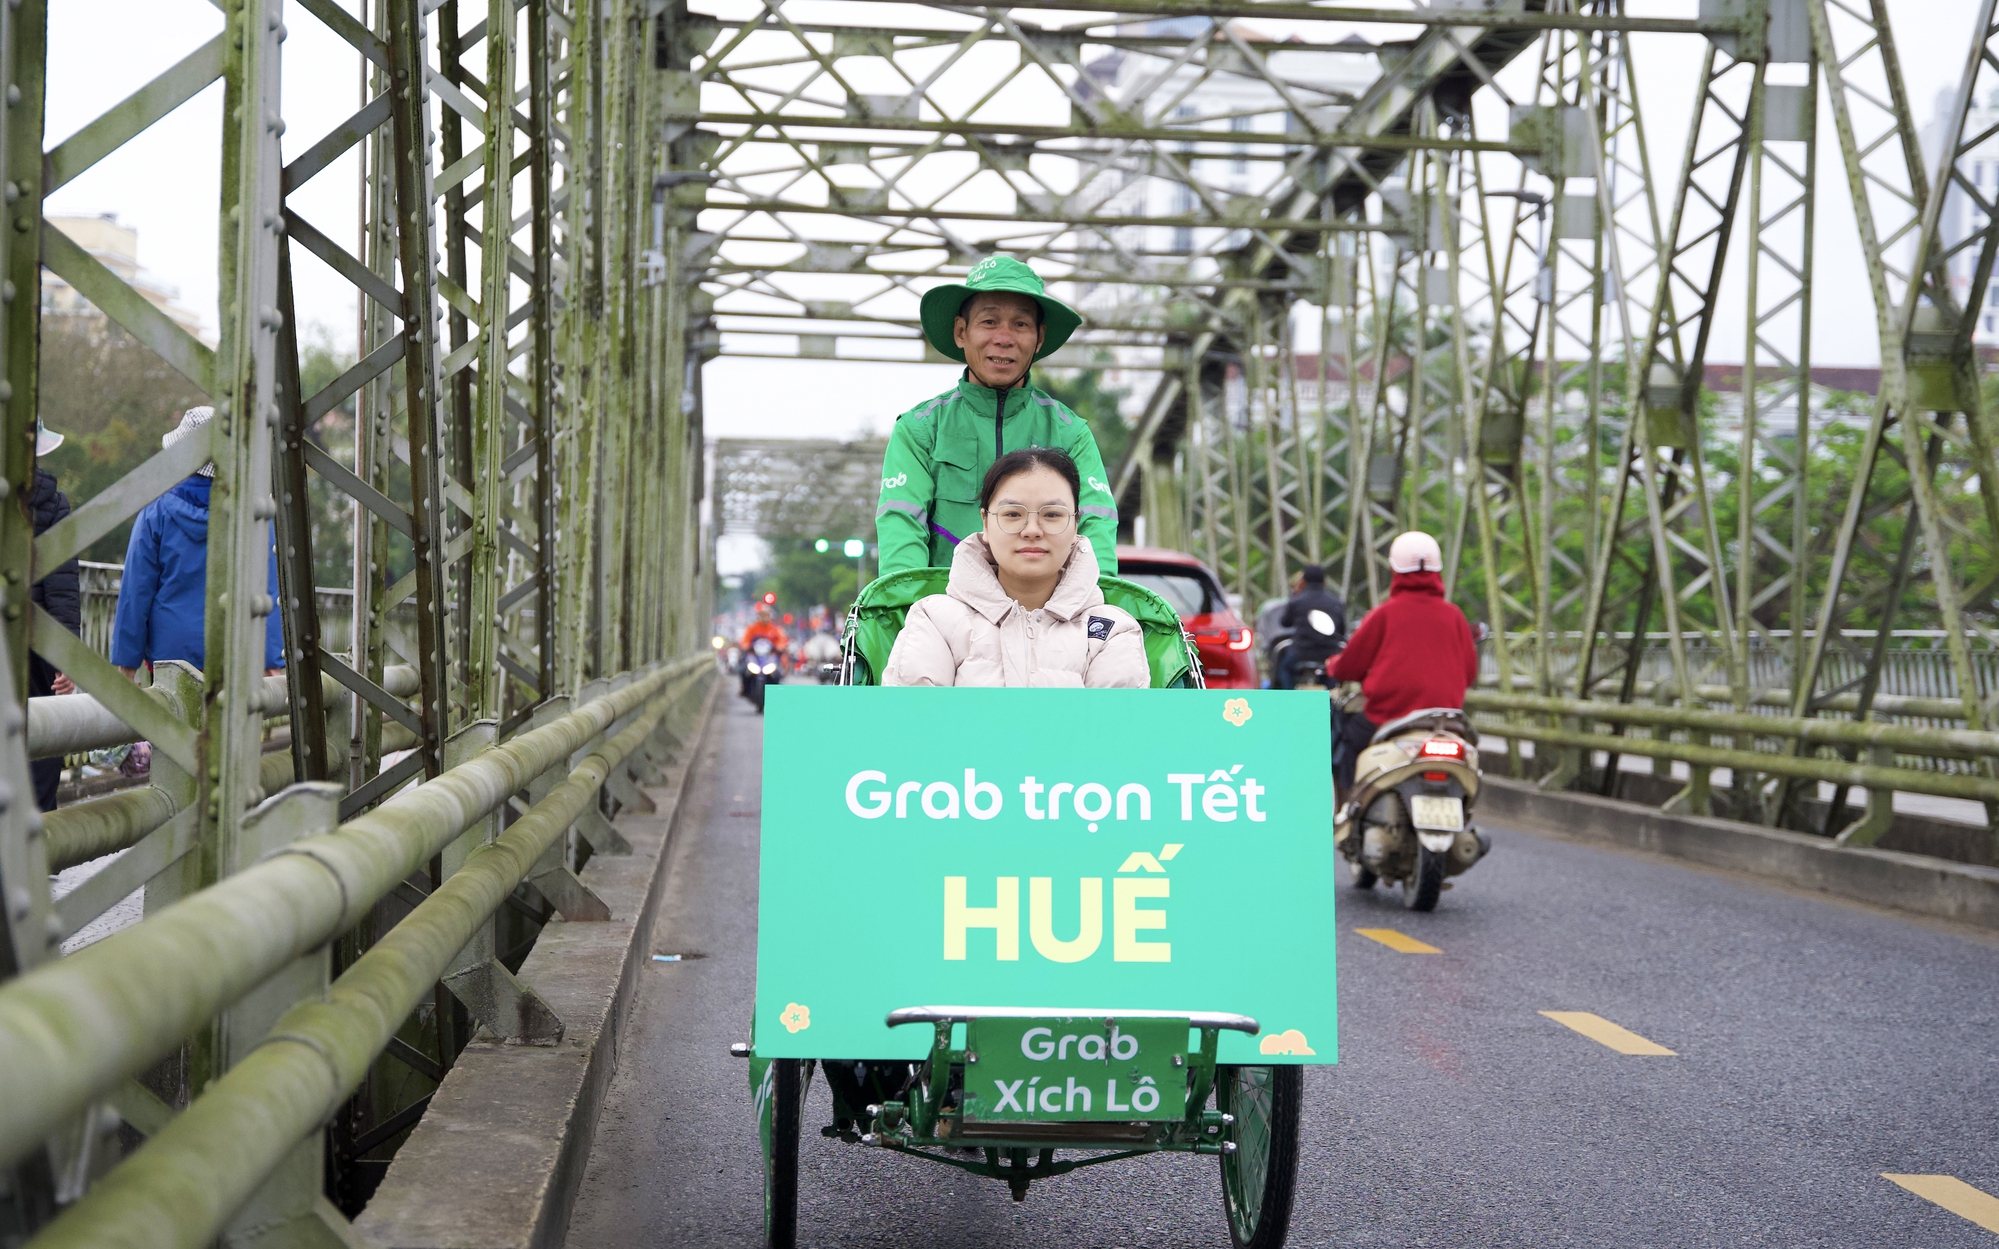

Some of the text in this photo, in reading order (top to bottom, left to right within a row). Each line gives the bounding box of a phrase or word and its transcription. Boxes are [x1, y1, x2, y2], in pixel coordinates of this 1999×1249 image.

[880, 471, 908, 493] rab
[845, 765, 1267, 833] Grab trọn Tết
[943, 843, 1185, 964] HUẾ
[1021, 1026, 1139, 1061] Grab
[993, 1076, 1160, 1113] Xích Lô
